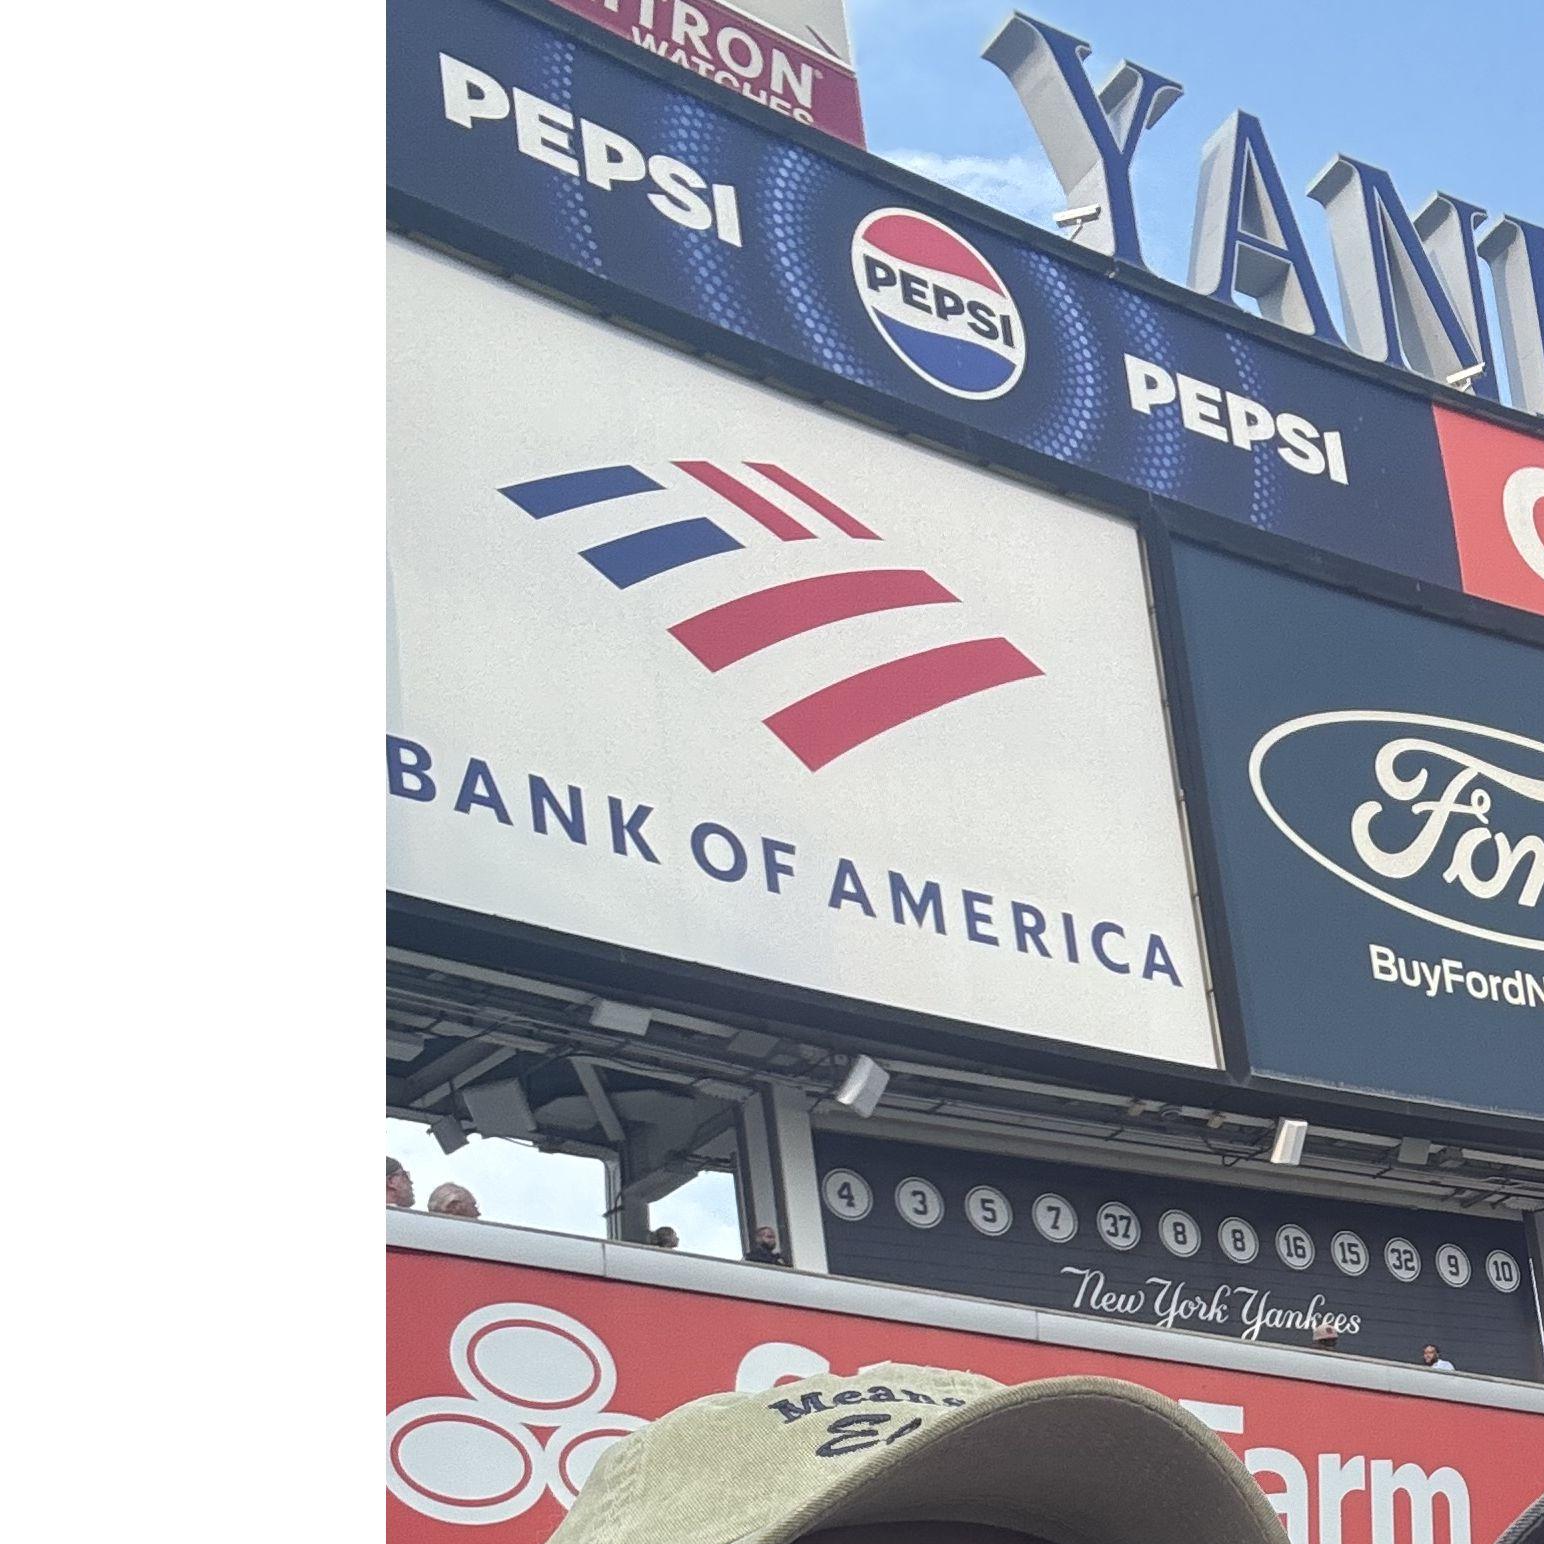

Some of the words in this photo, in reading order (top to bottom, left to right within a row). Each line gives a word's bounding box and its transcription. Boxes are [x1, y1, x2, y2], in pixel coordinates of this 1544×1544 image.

[438, 52, 743, 248] PEPSI
[863, 253, 1017, 349] PEPSI
[1123, 352, 1349, 485] PEPSI
[386, 735, 661, 865] BANK
[690, 822, 798, 895] OF
[828, 858, 1184, 988] AMERICA
[837, 1181, 856, 1208] 4
[911, 1190, 928, 1216] 3
[980, 1198, 998, 1224] 5
[1047, 1205, 1062, 1230] 7
[1103, 1213, 1133, 1240] 37
[1173, 1221, 1187, 1246] 8
[1231, 1228, 1246, 1252] 8
[1284, 1234, 1307, 1260] 16
[1339, 1241, 1362, 1266] 15
[1390, 1248, 1416, 1272] 32
[1448, 1254, 1461, 1277] 9
[1492, 1260, 1513, 1283] 10
[1061, 1266, 1145, 1314] New
[1145, 1277, 1231, 1329] York
[1233, 1286, 1362, 1341] Yankees
